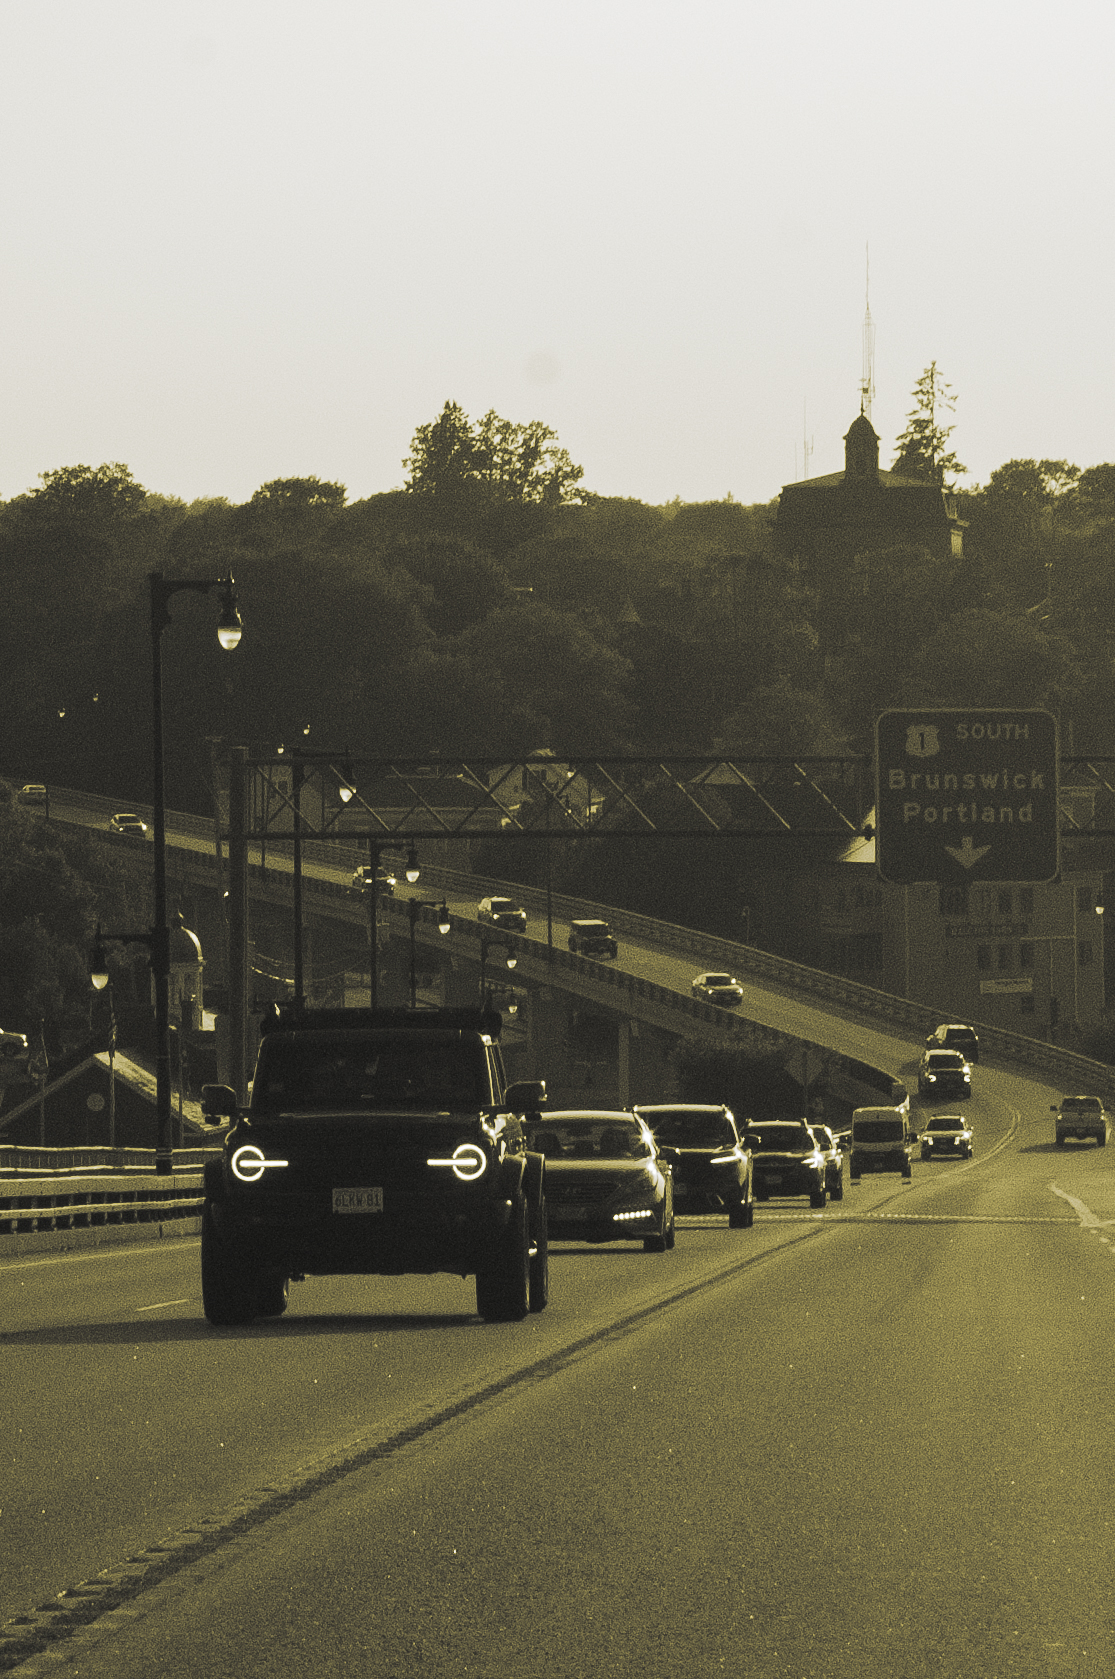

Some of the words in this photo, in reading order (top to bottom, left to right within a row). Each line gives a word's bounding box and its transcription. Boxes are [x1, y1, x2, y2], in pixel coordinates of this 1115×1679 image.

[956, 723, 1030, 740] SOUTH
[888, 768, 1045, 790] Brunswick
[903, 800, 1033, 823] Portland
